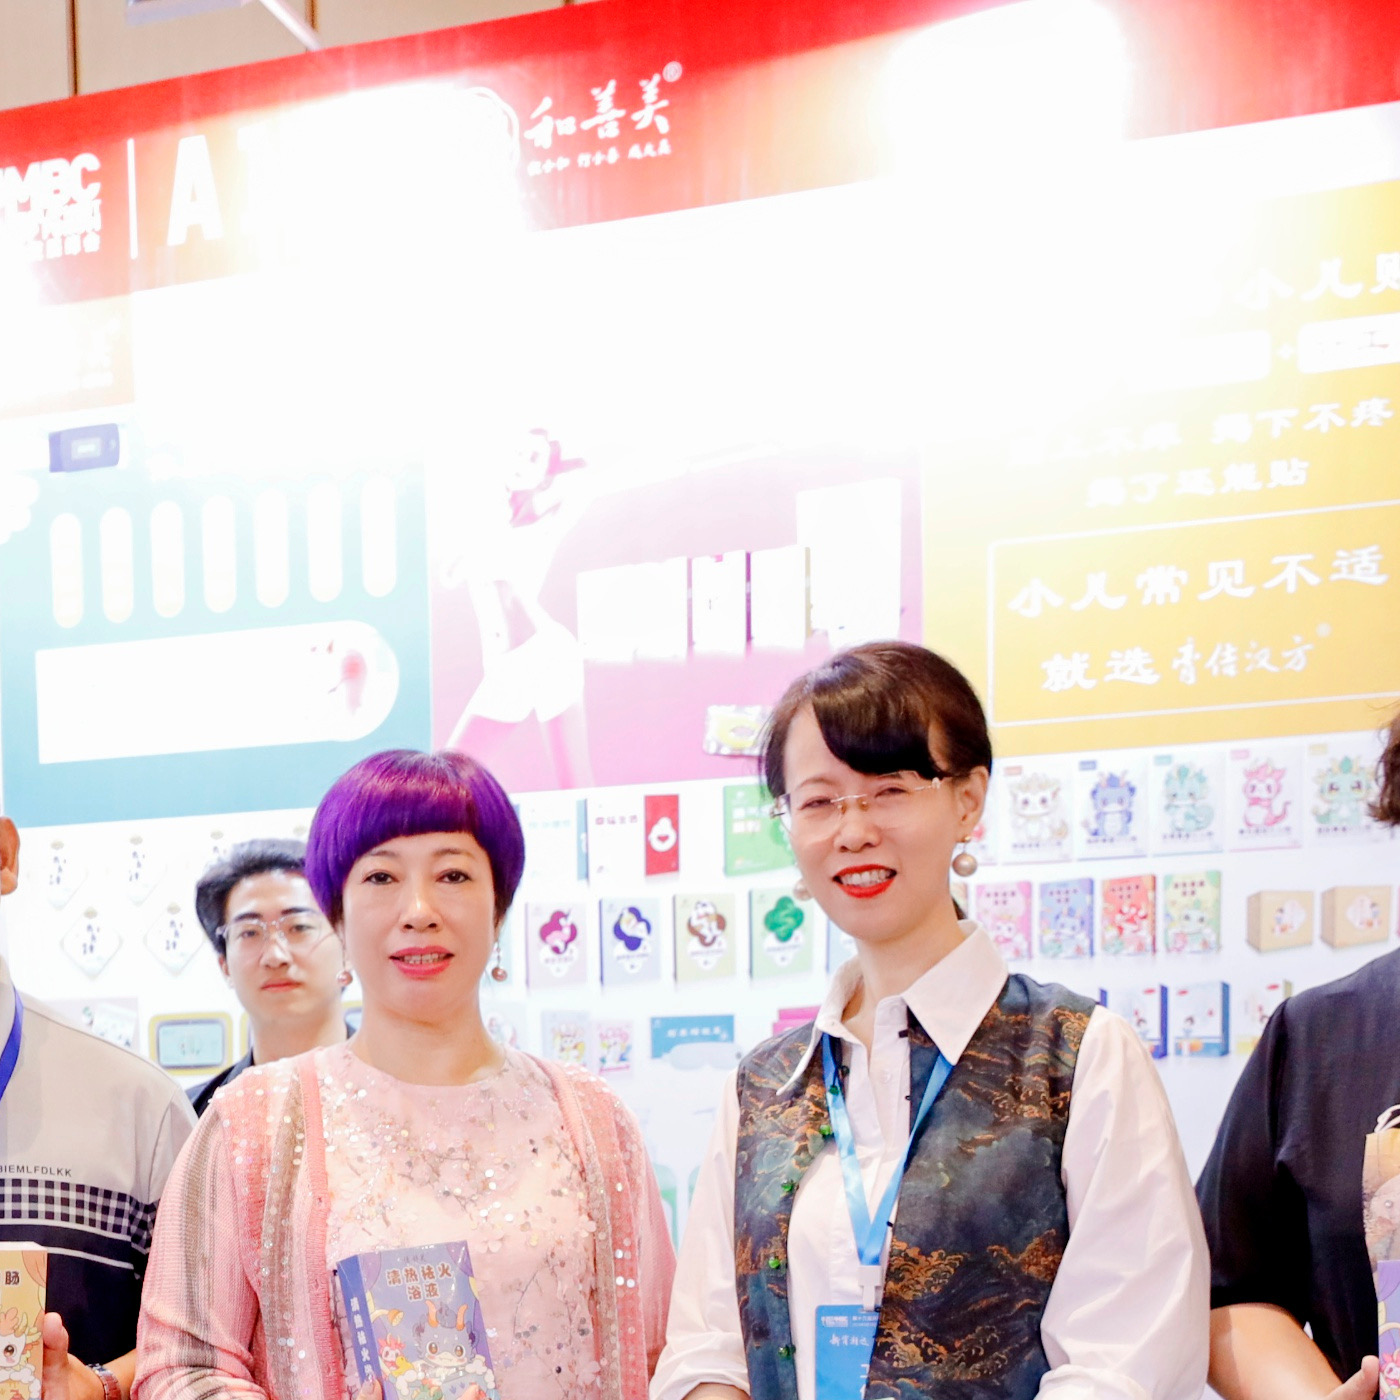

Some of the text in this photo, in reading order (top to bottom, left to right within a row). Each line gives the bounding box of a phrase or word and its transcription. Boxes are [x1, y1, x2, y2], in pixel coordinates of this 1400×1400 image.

[524, 73, 670, 148] 和善美
[1008, 545, 1389, 618] 小儿常见不适
[407, 1282, 440, 1301] 浴液
